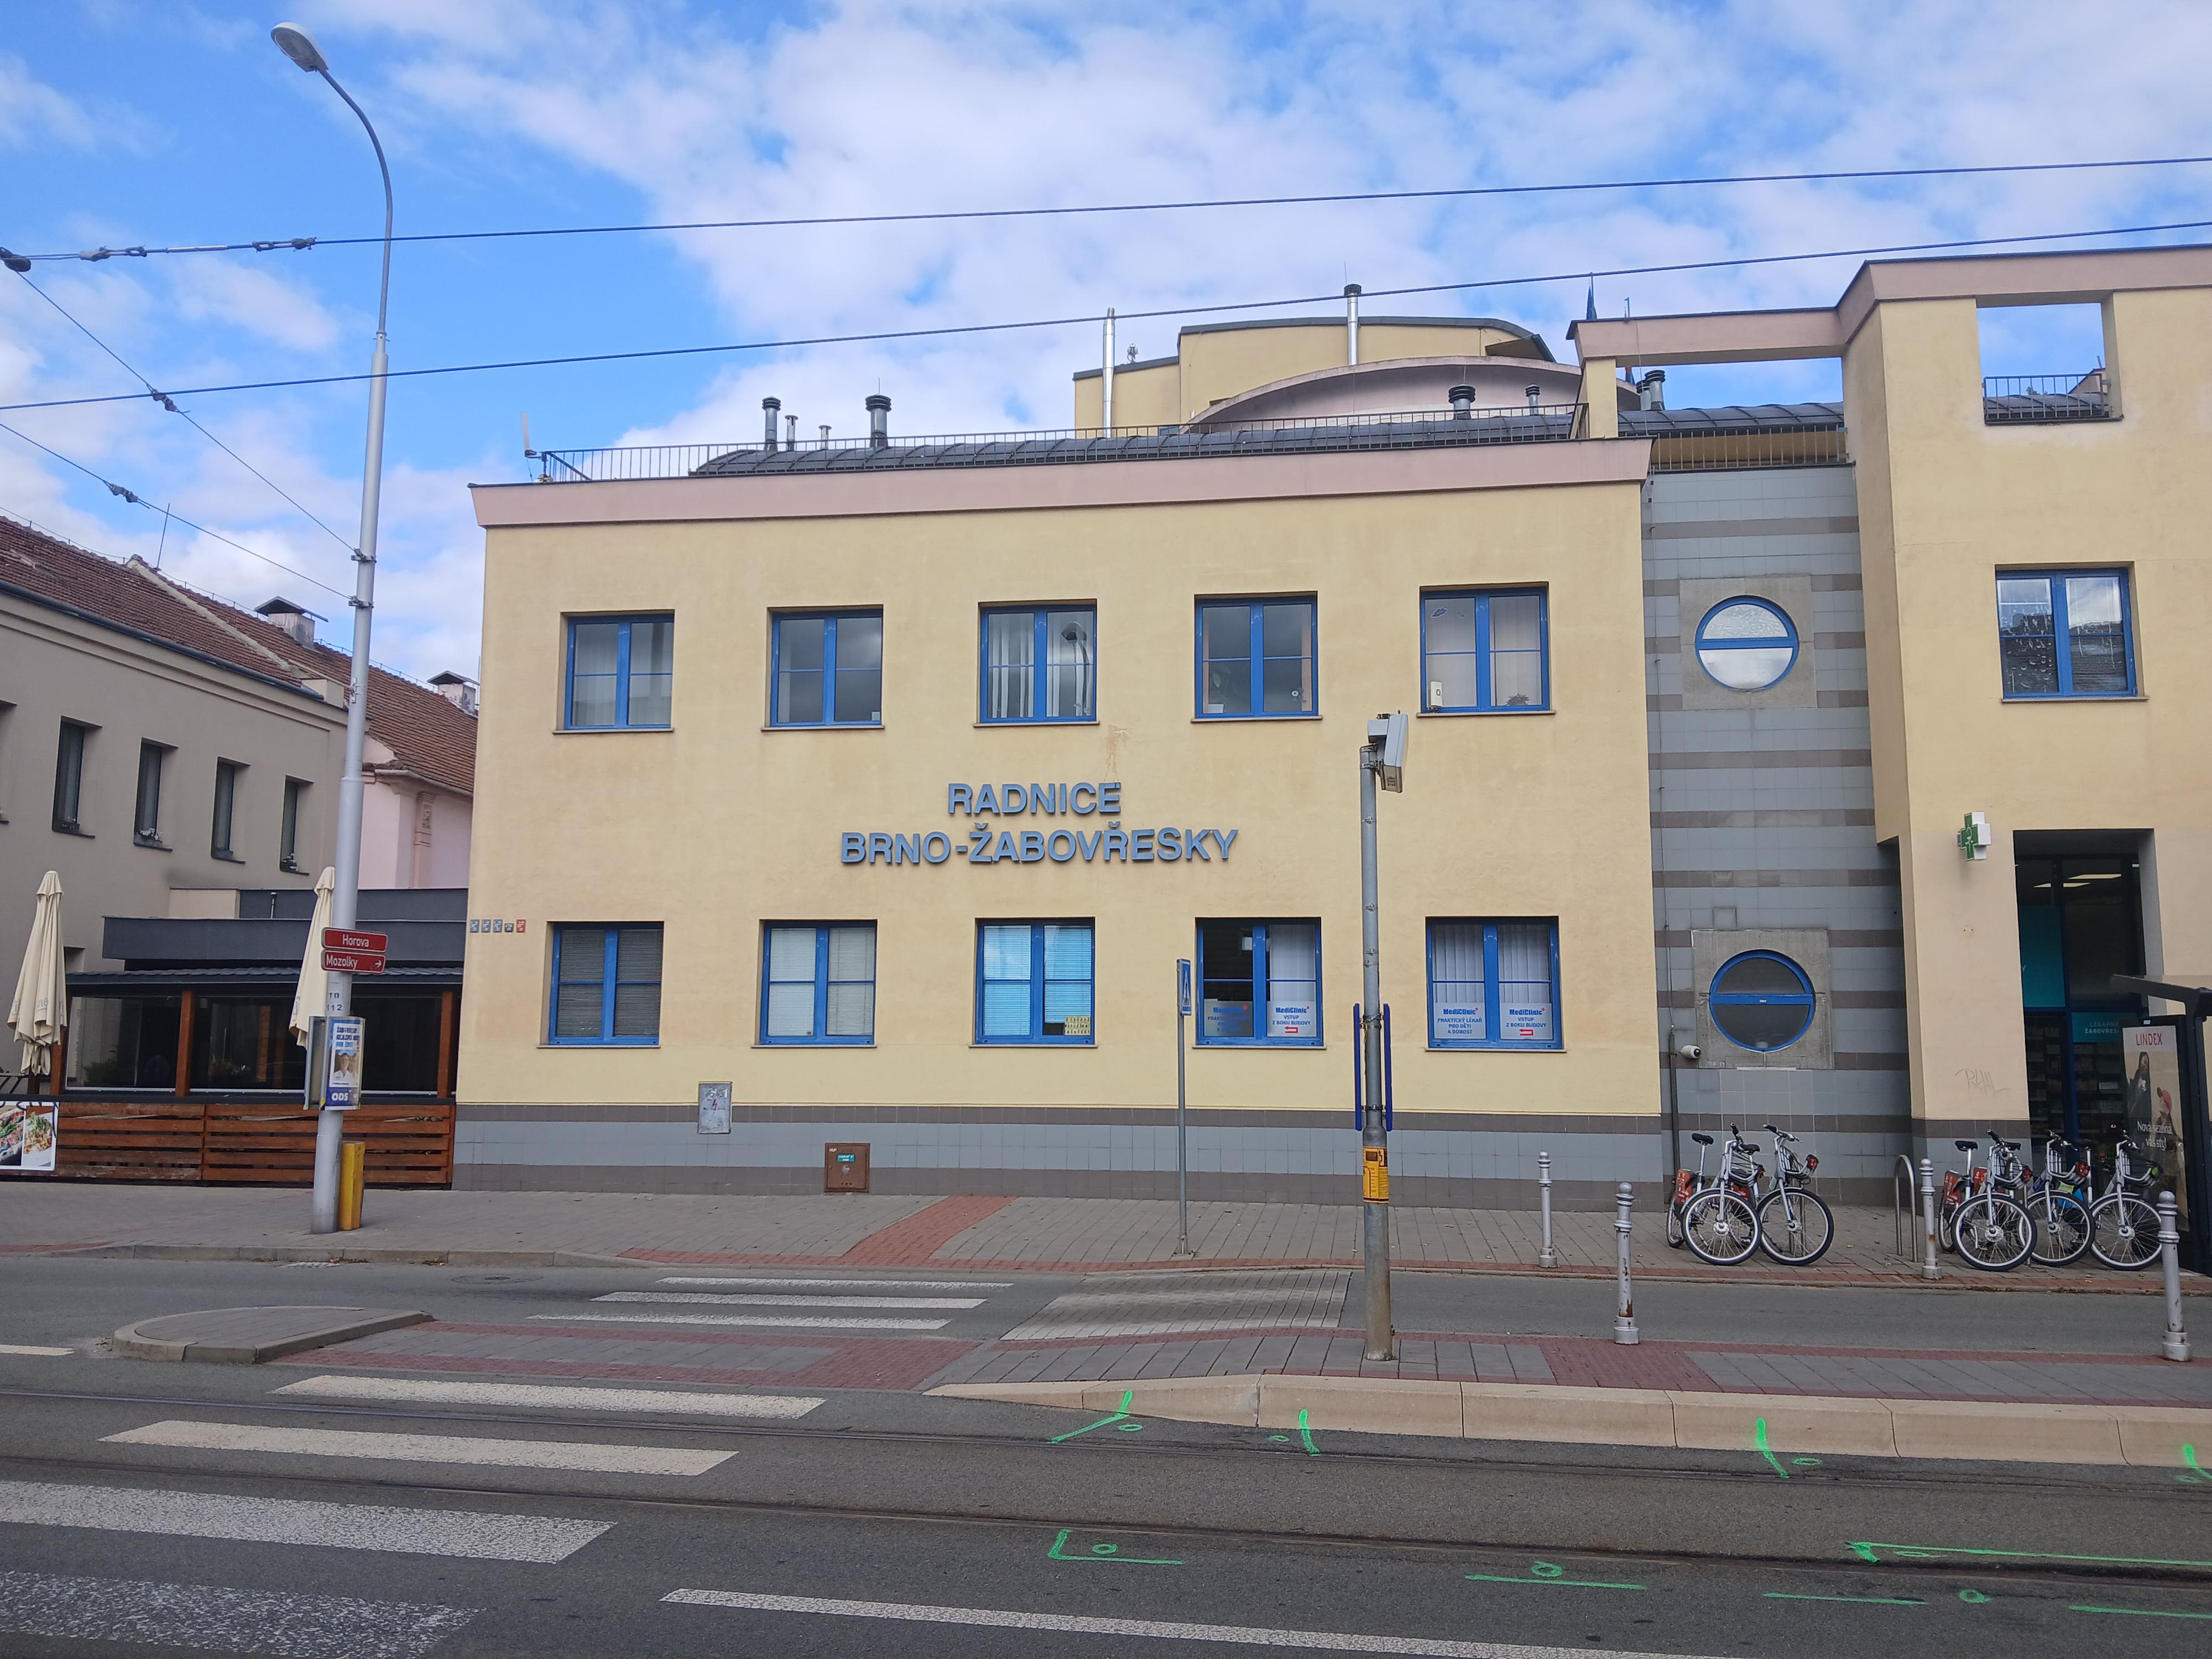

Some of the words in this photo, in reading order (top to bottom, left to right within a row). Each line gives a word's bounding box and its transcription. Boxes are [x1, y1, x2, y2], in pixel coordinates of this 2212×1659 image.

[948, 782, 1121, 814] RADNICE
[841, 821, 1239, 864] BRNO-ŽABOVŘESKY
[342, 934, 369, 947] Horova
[326, 954, 358, 970] Mozolky
[2135, 1032, 2163, 1046] LINDEX
[331, 1092, 349, 1101] ODS
